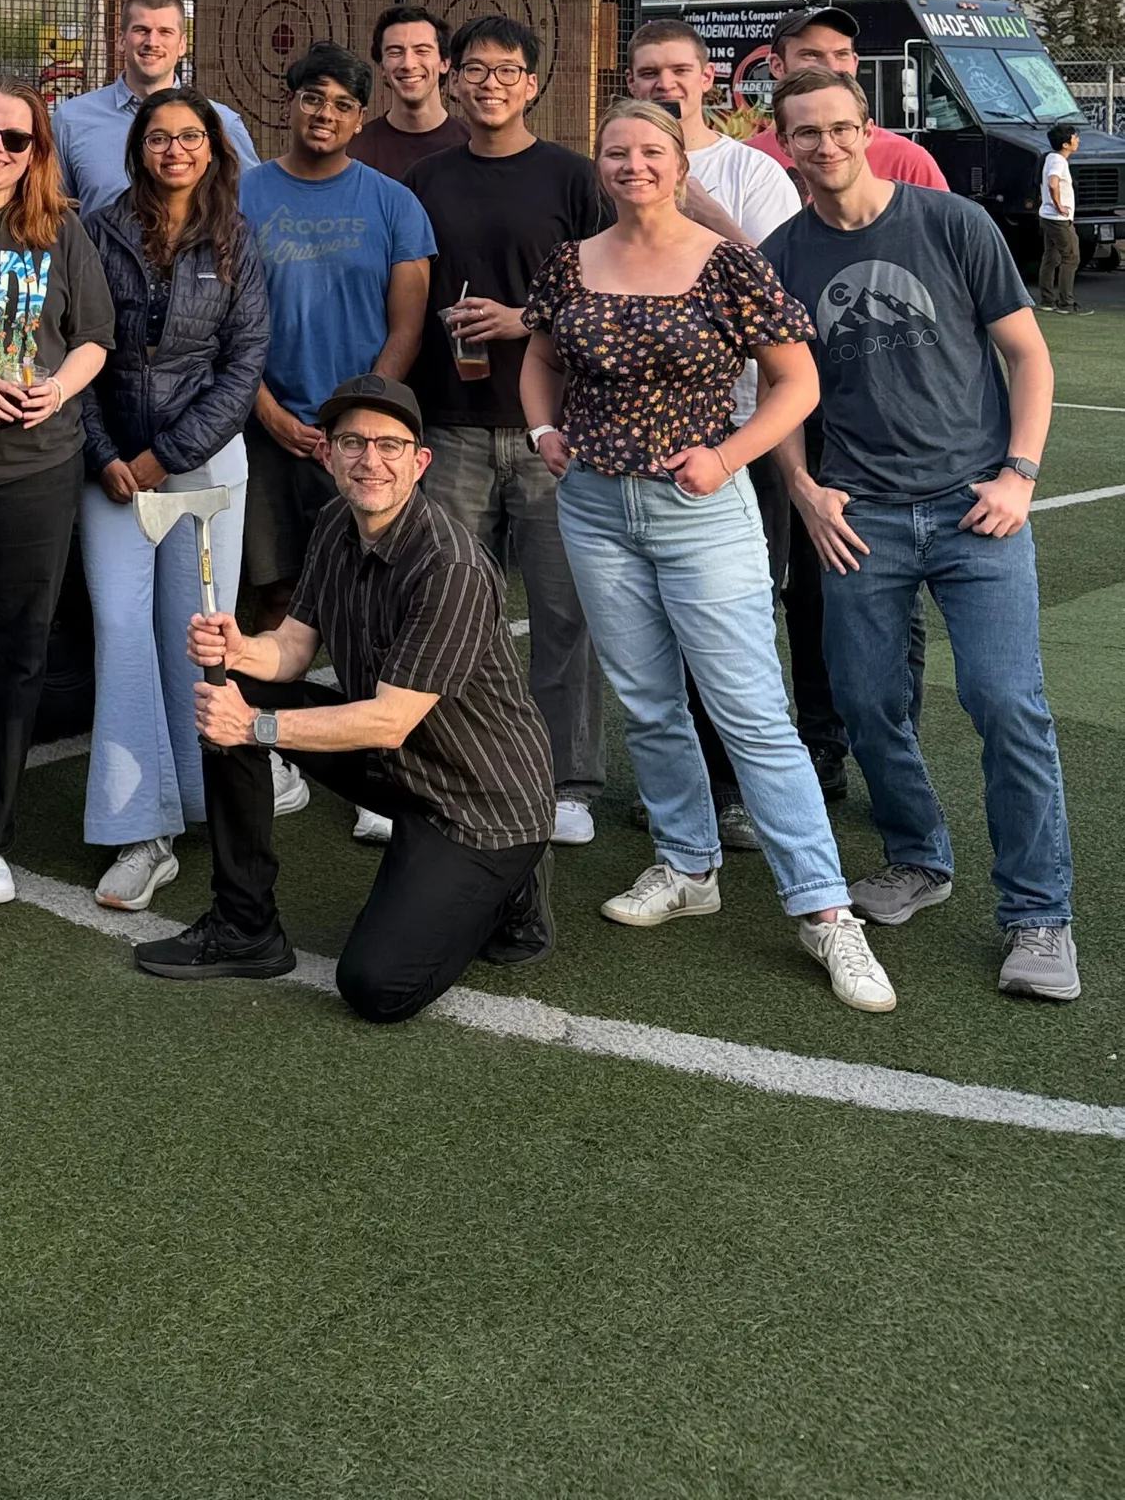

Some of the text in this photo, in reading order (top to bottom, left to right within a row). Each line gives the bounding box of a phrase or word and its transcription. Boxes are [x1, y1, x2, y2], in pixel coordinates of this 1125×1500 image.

[712, 10, 740, 21] Private
[922, 13, 1031, 38] MADE IN ITALY
[734, 82, 772, 92] MADE IN
[279, 217, 367, 235] ROOTS
[273, 236, 361, 265] Outdoors
[828, 328, 940, 364] COLORADO
